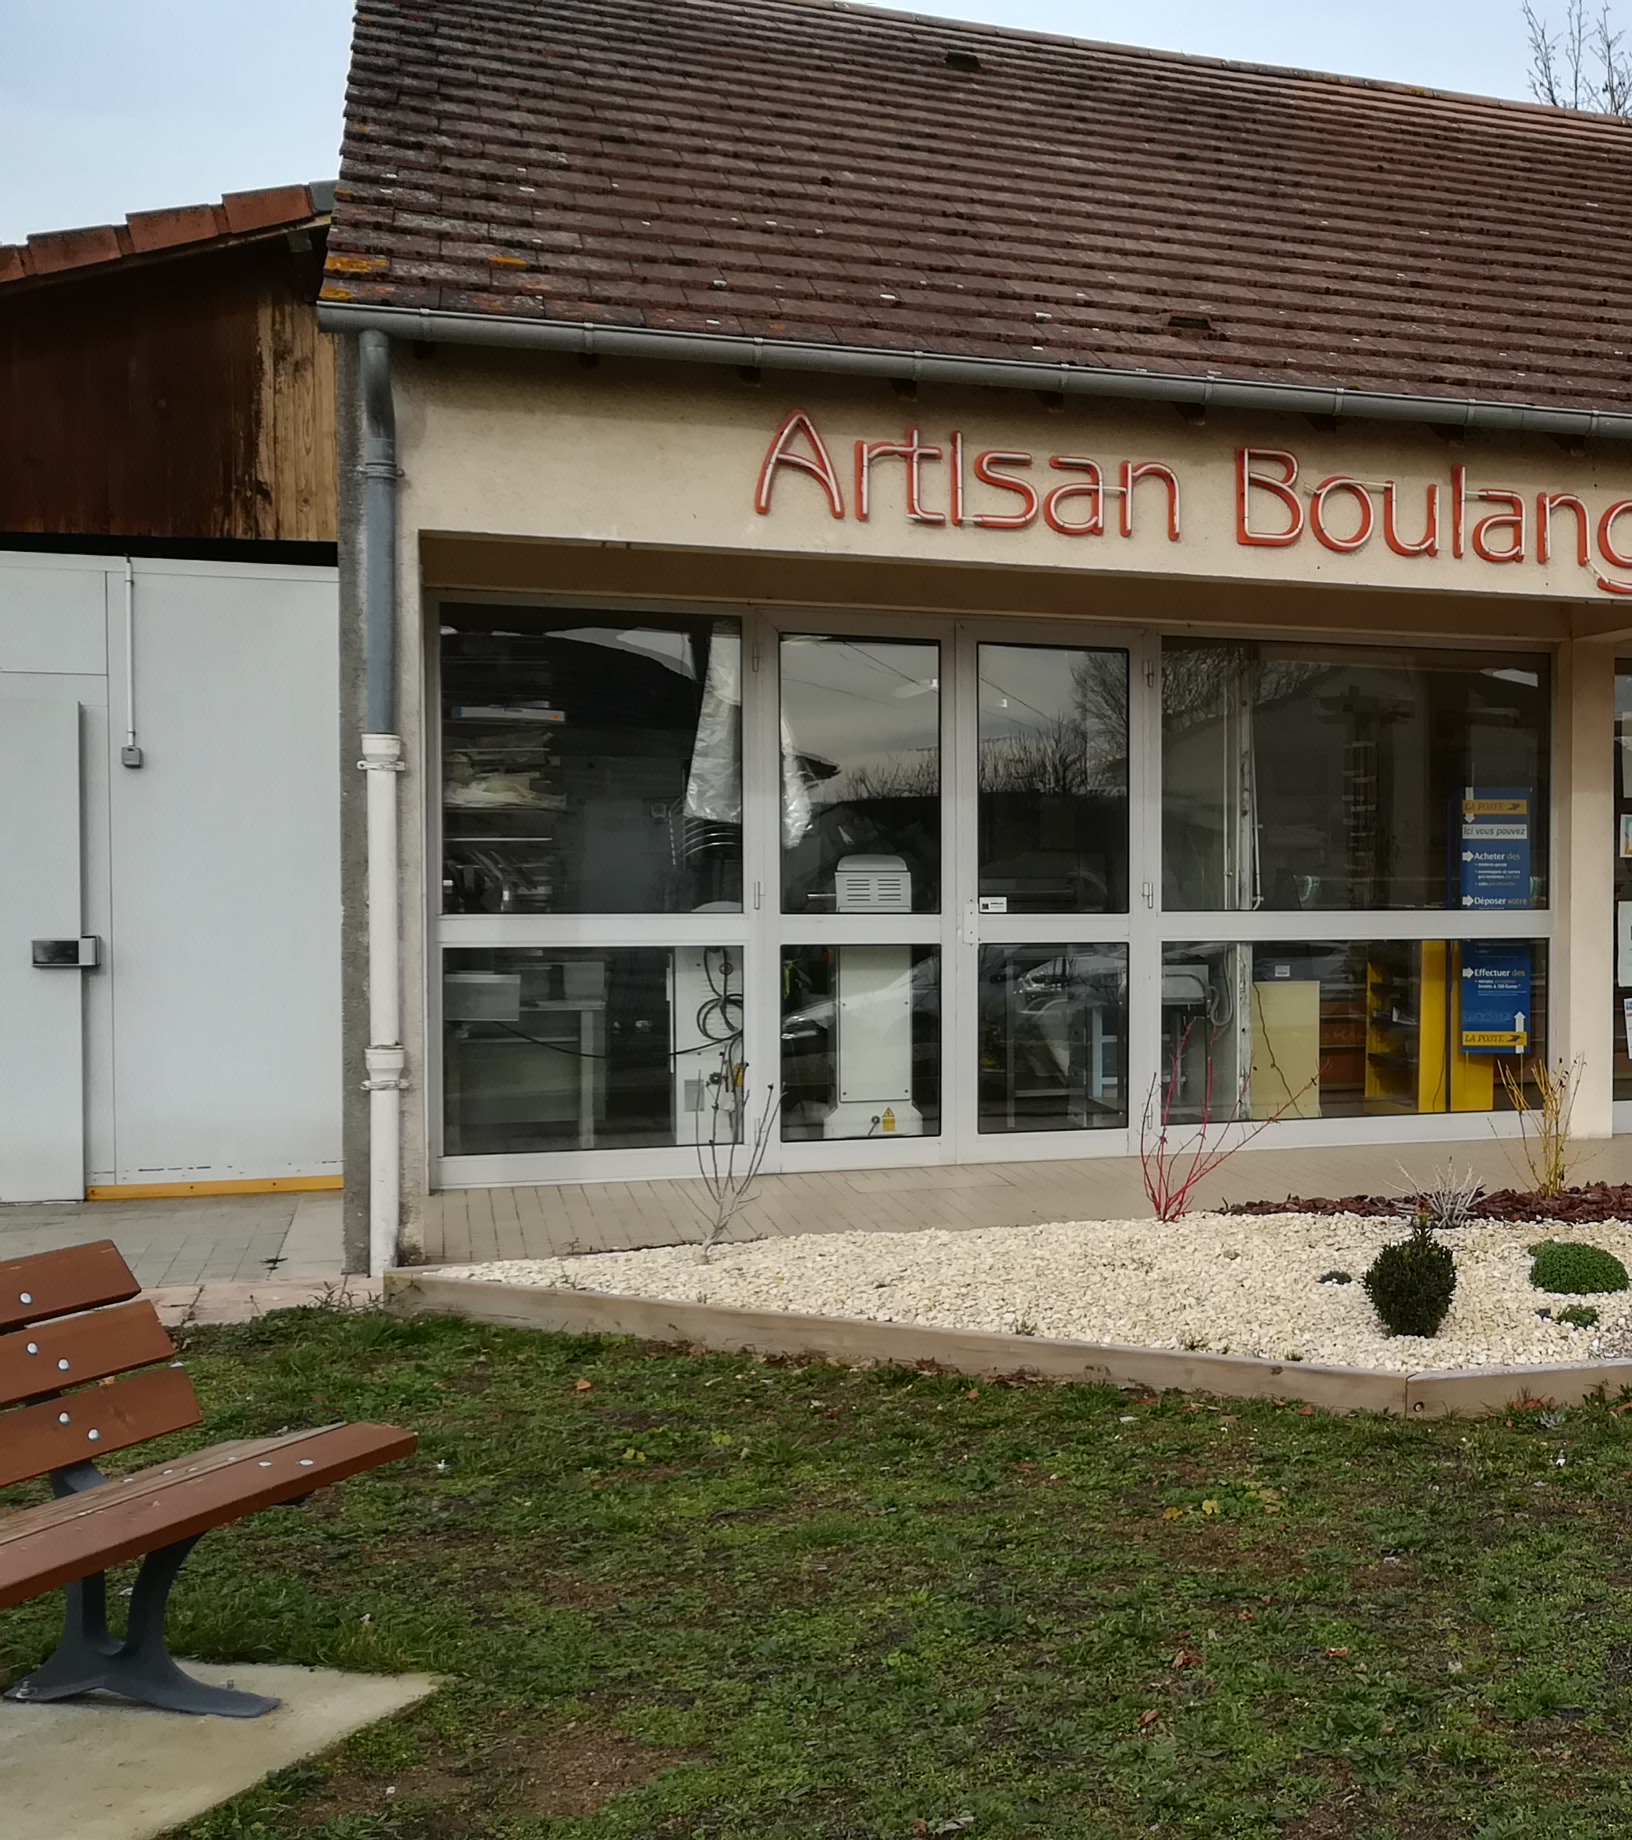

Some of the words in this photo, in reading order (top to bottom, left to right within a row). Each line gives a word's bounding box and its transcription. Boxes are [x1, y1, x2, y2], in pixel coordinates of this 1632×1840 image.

[755, 409, 1181, 541] Artisan
[1463, 827, 1474, 835] Ici
[1496, 828, 1526, 837] pouvez
[1474, 852, 1505, 860] Acheter
[1507, 852, 1520, 860] des
[1474, 896, 1506, 906] Déposer
[1474, 968, 1510, 977] Effectuer
[1512, 968, 1526, 977] des
[1464, 1034, 1476, 1042] LA
[1478, 1034, 1505, 1042] POSTE
